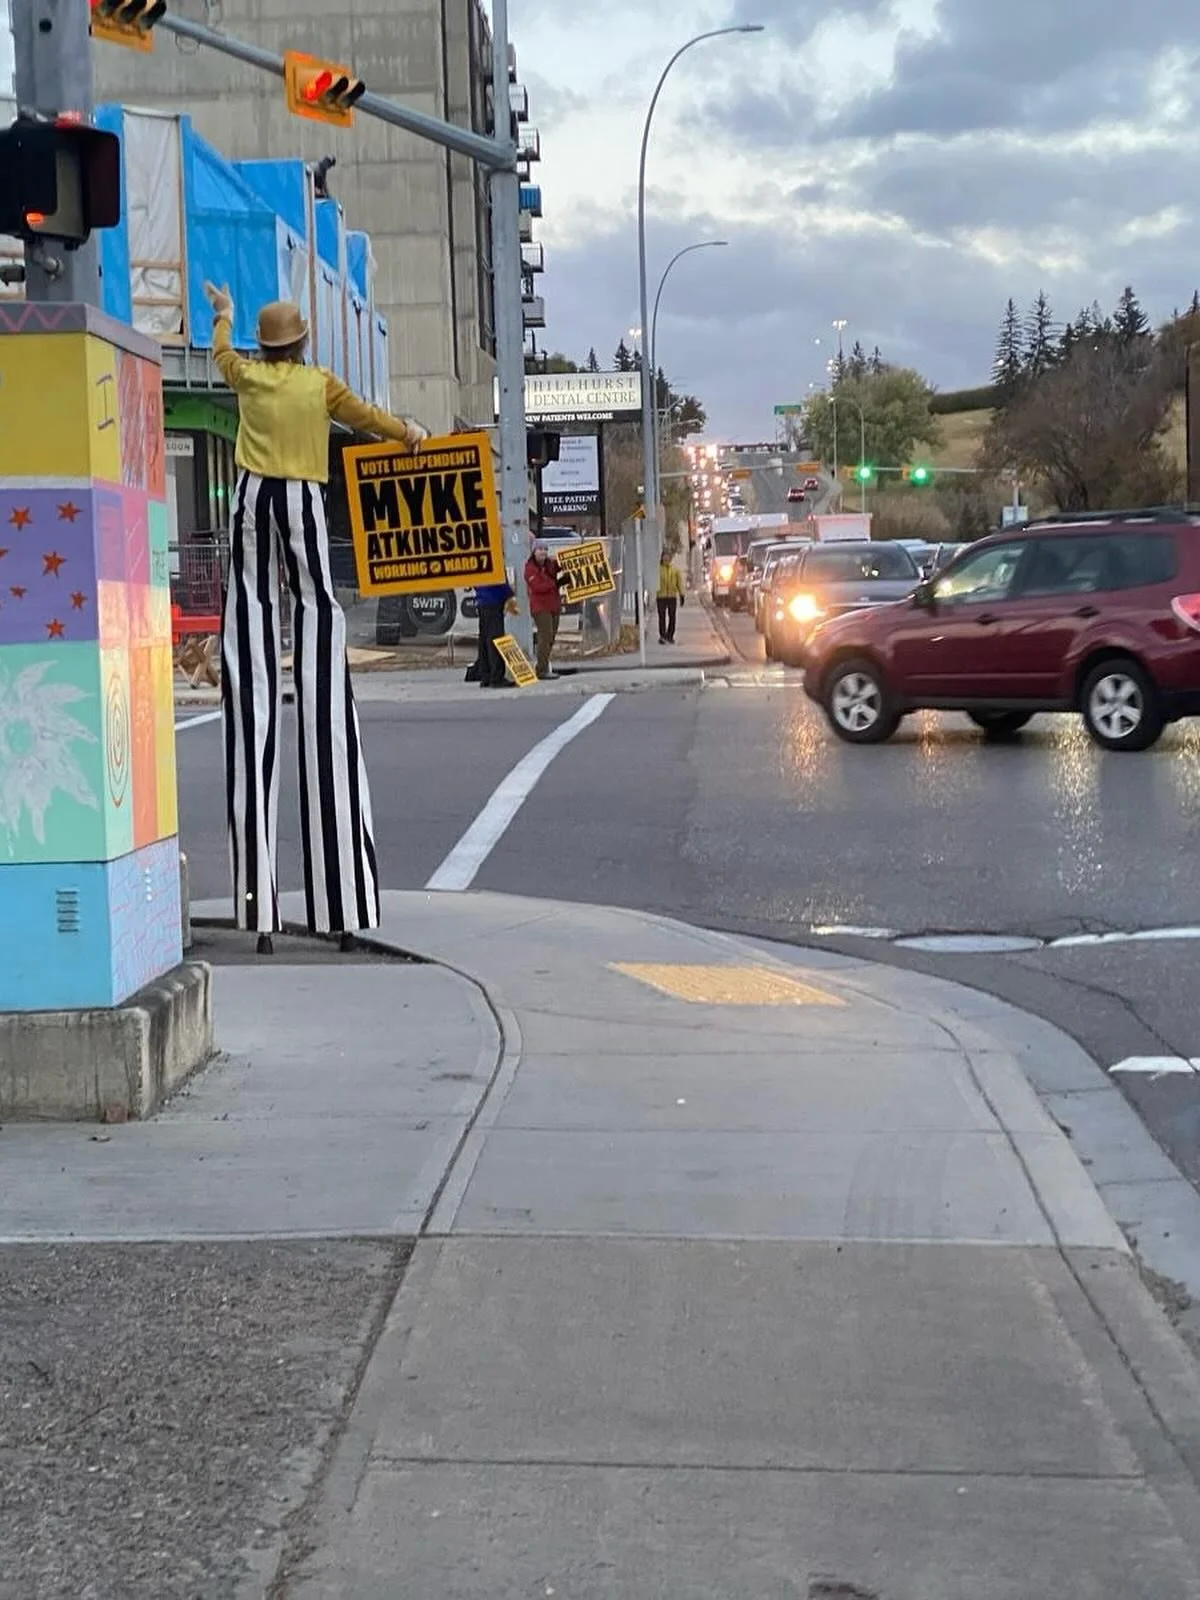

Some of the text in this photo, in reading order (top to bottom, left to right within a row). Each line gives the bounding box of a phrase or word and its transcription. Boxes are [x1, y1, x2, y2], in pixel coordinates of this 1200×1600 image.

[534, 377, 636, 392] HILLHURST
[534, 391, 636, 406] DENTAL CENTRE
[541, 413, 576, 422] PATIENTS
[576, 412, 614, 420] WELCOME
[360, 449, 477, 476] VOTE INDEPENDENT!
[359, 470, 488, 532] MYKE
[544, 494, 598, 504] FREE PATIENT
[552, 504, 588, 512] PARKING
[367, 521, 491, 560] ATKINSON
[374, 556, 488, 580] WORKING WARD 7
[412, 597, 445, 609] SWIFT
